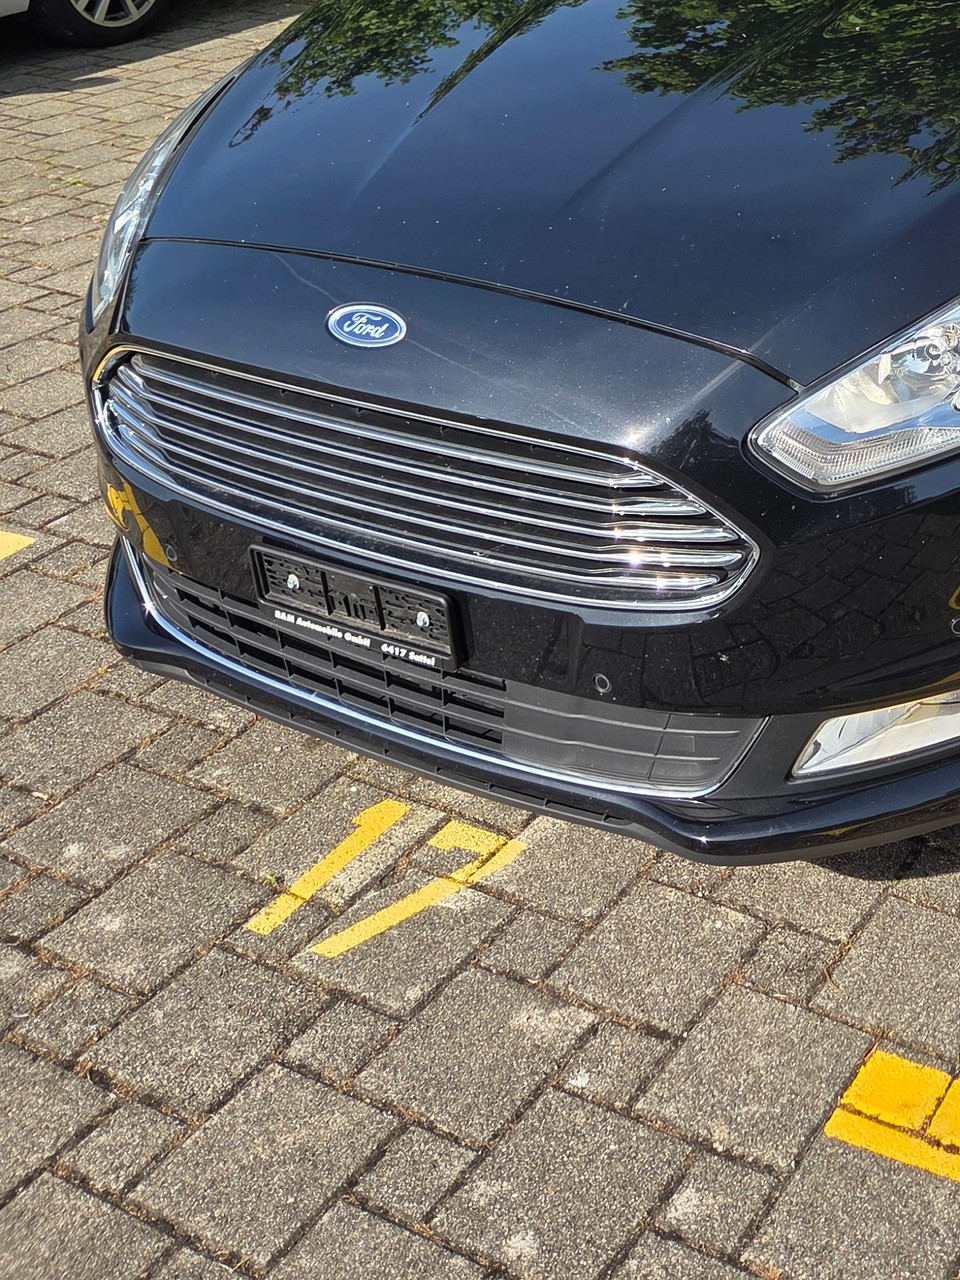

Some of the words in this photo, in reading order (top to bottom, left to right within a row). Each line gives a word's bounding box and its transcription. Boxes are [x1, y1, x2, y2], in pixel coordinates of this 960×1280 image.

[343, 312, 390, 338] Ford
[296, 617, 343, 639] Automobile
[344, 632, 371, 648] GmbH
[381, 643, 407, 658] 6417
[244, 798, 528, 958] 17
